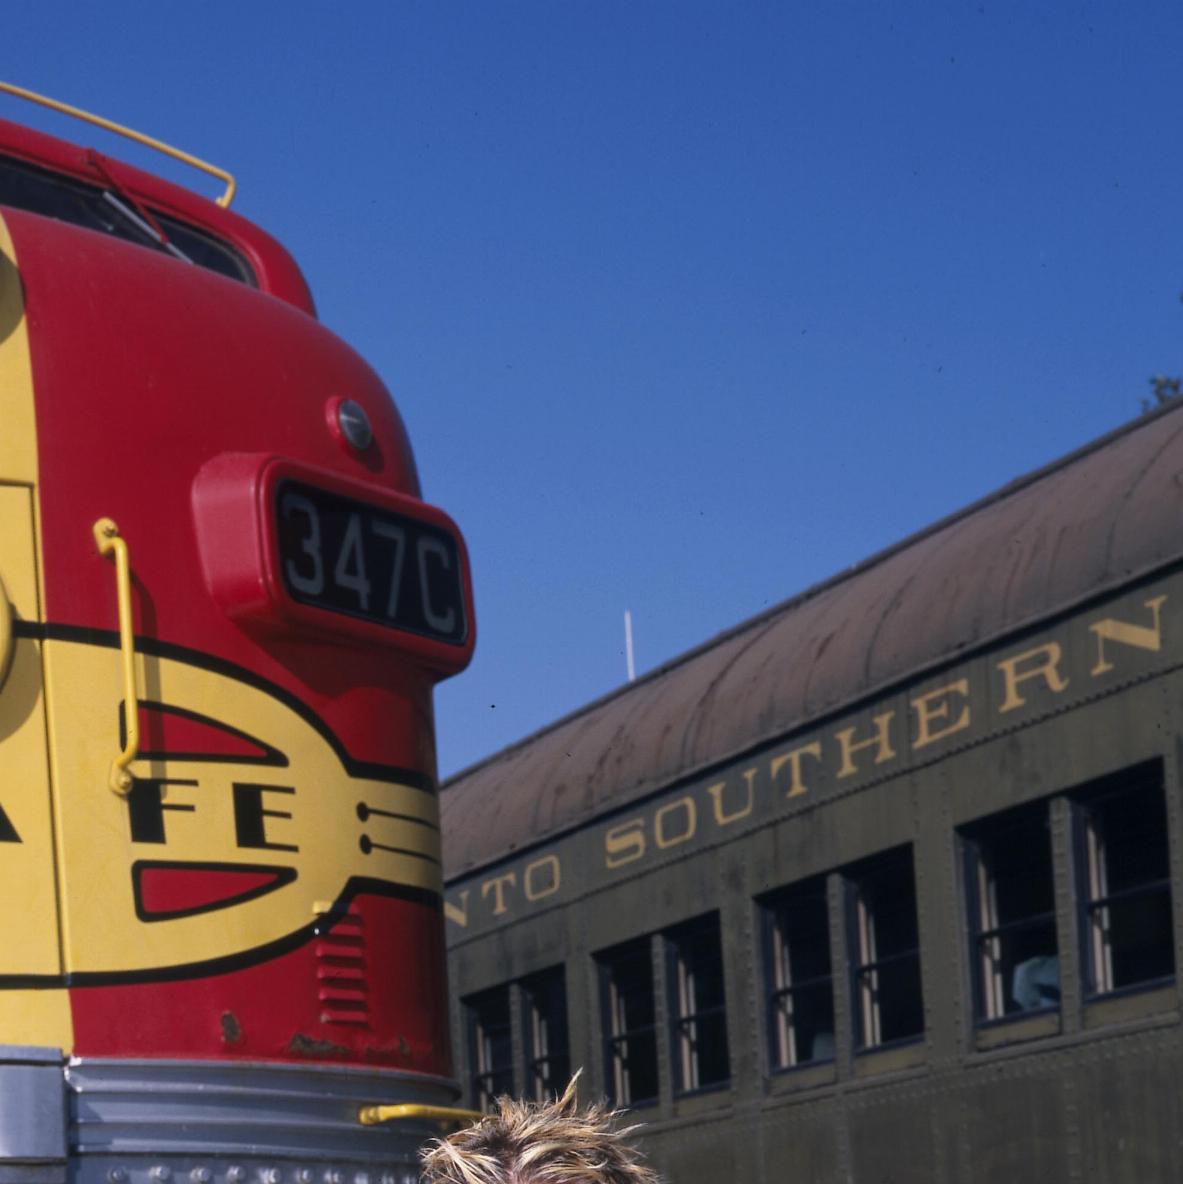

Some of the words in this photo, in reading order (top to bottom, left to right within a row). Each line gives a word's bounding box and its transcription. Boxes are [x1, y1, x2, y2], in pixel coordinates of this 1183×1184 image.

[280, 492, 456, 635] 347C
[604, 594, 1169, 871] SOUTHERN
[127, 777, 300, 853] FE
